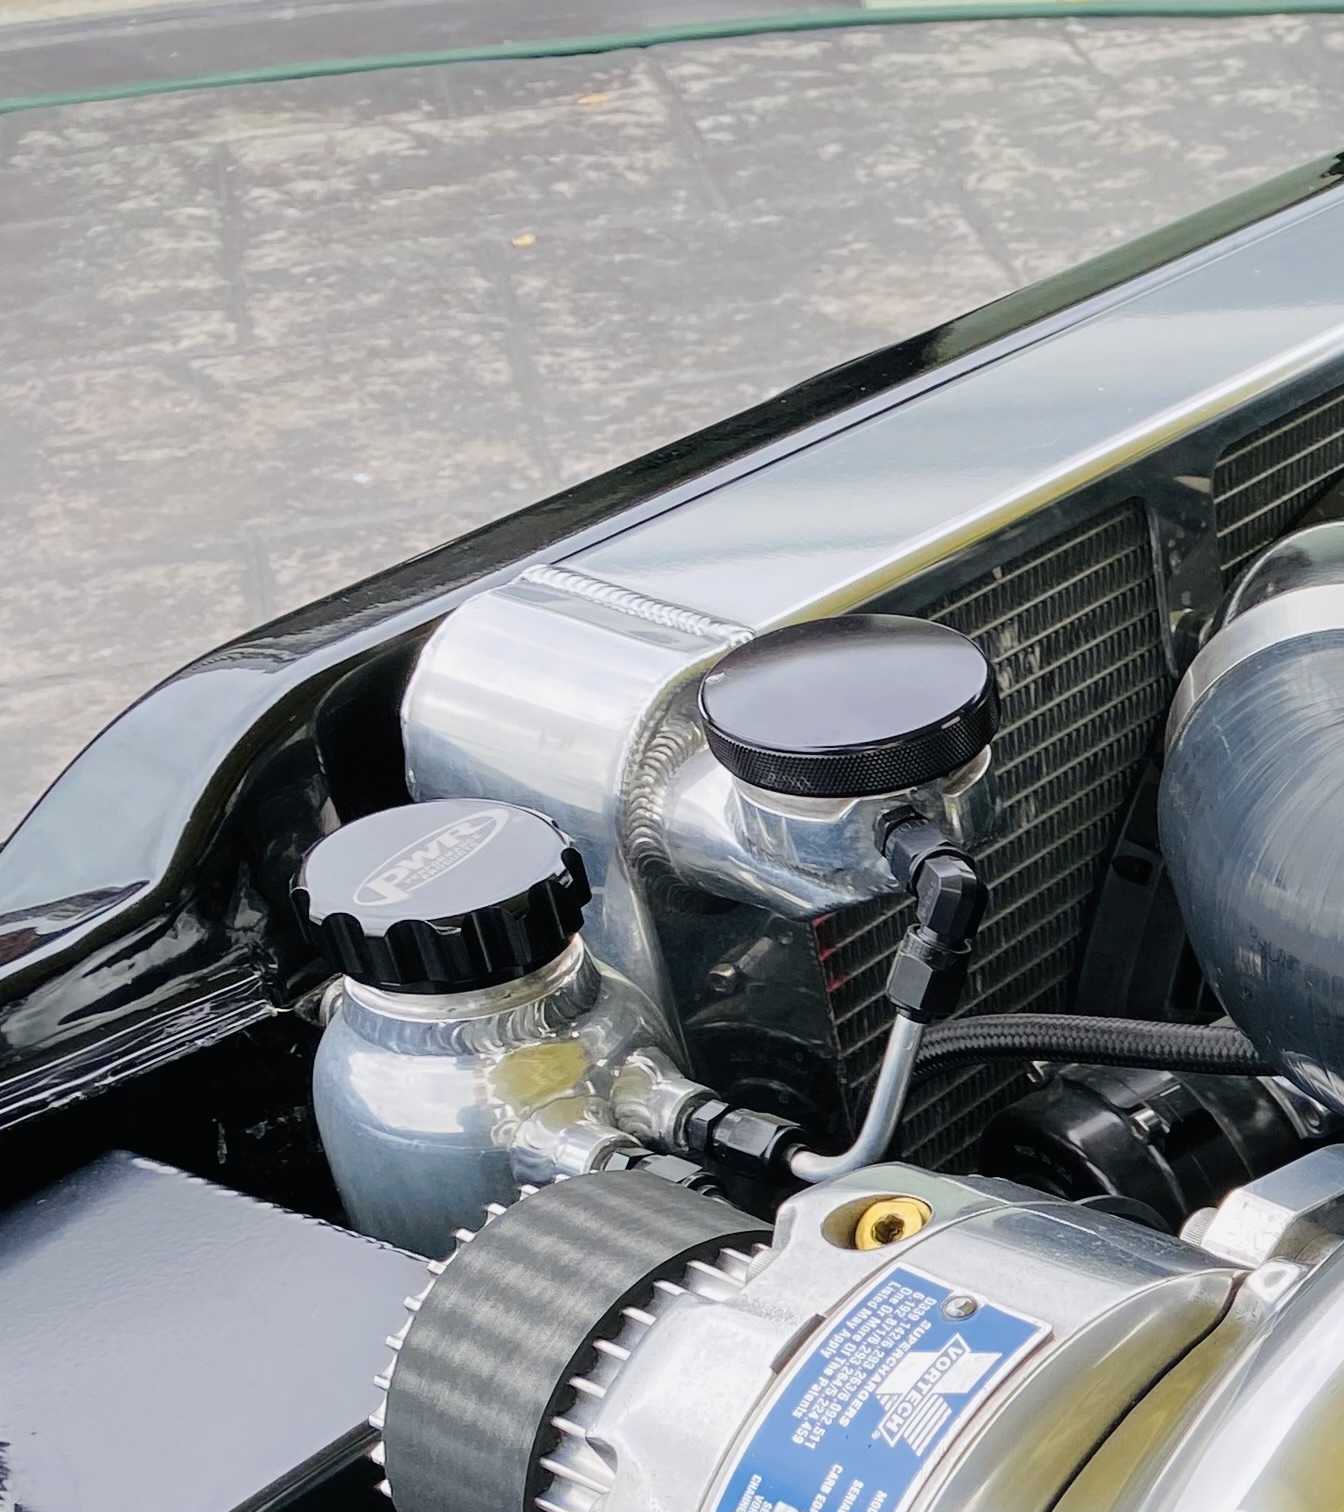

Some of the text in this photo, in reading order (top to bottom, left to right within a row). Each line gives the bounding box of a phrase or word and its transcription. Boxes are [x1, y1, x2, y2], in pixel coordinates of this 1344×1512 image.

[364, 819, 487, 900] PWR
[404, 834, 481, 884] PERFORMANCE
[791, 1285, 912, 1419] One Or More Of The Patents
[819, 1280, 900, 1358] Listed May Apply
[837, 1318, 932, 1428] SUPERCHARGERS
[884, 1348, 962, 1433] VORTECH
[819, 1463, 843, 1494] CARB
